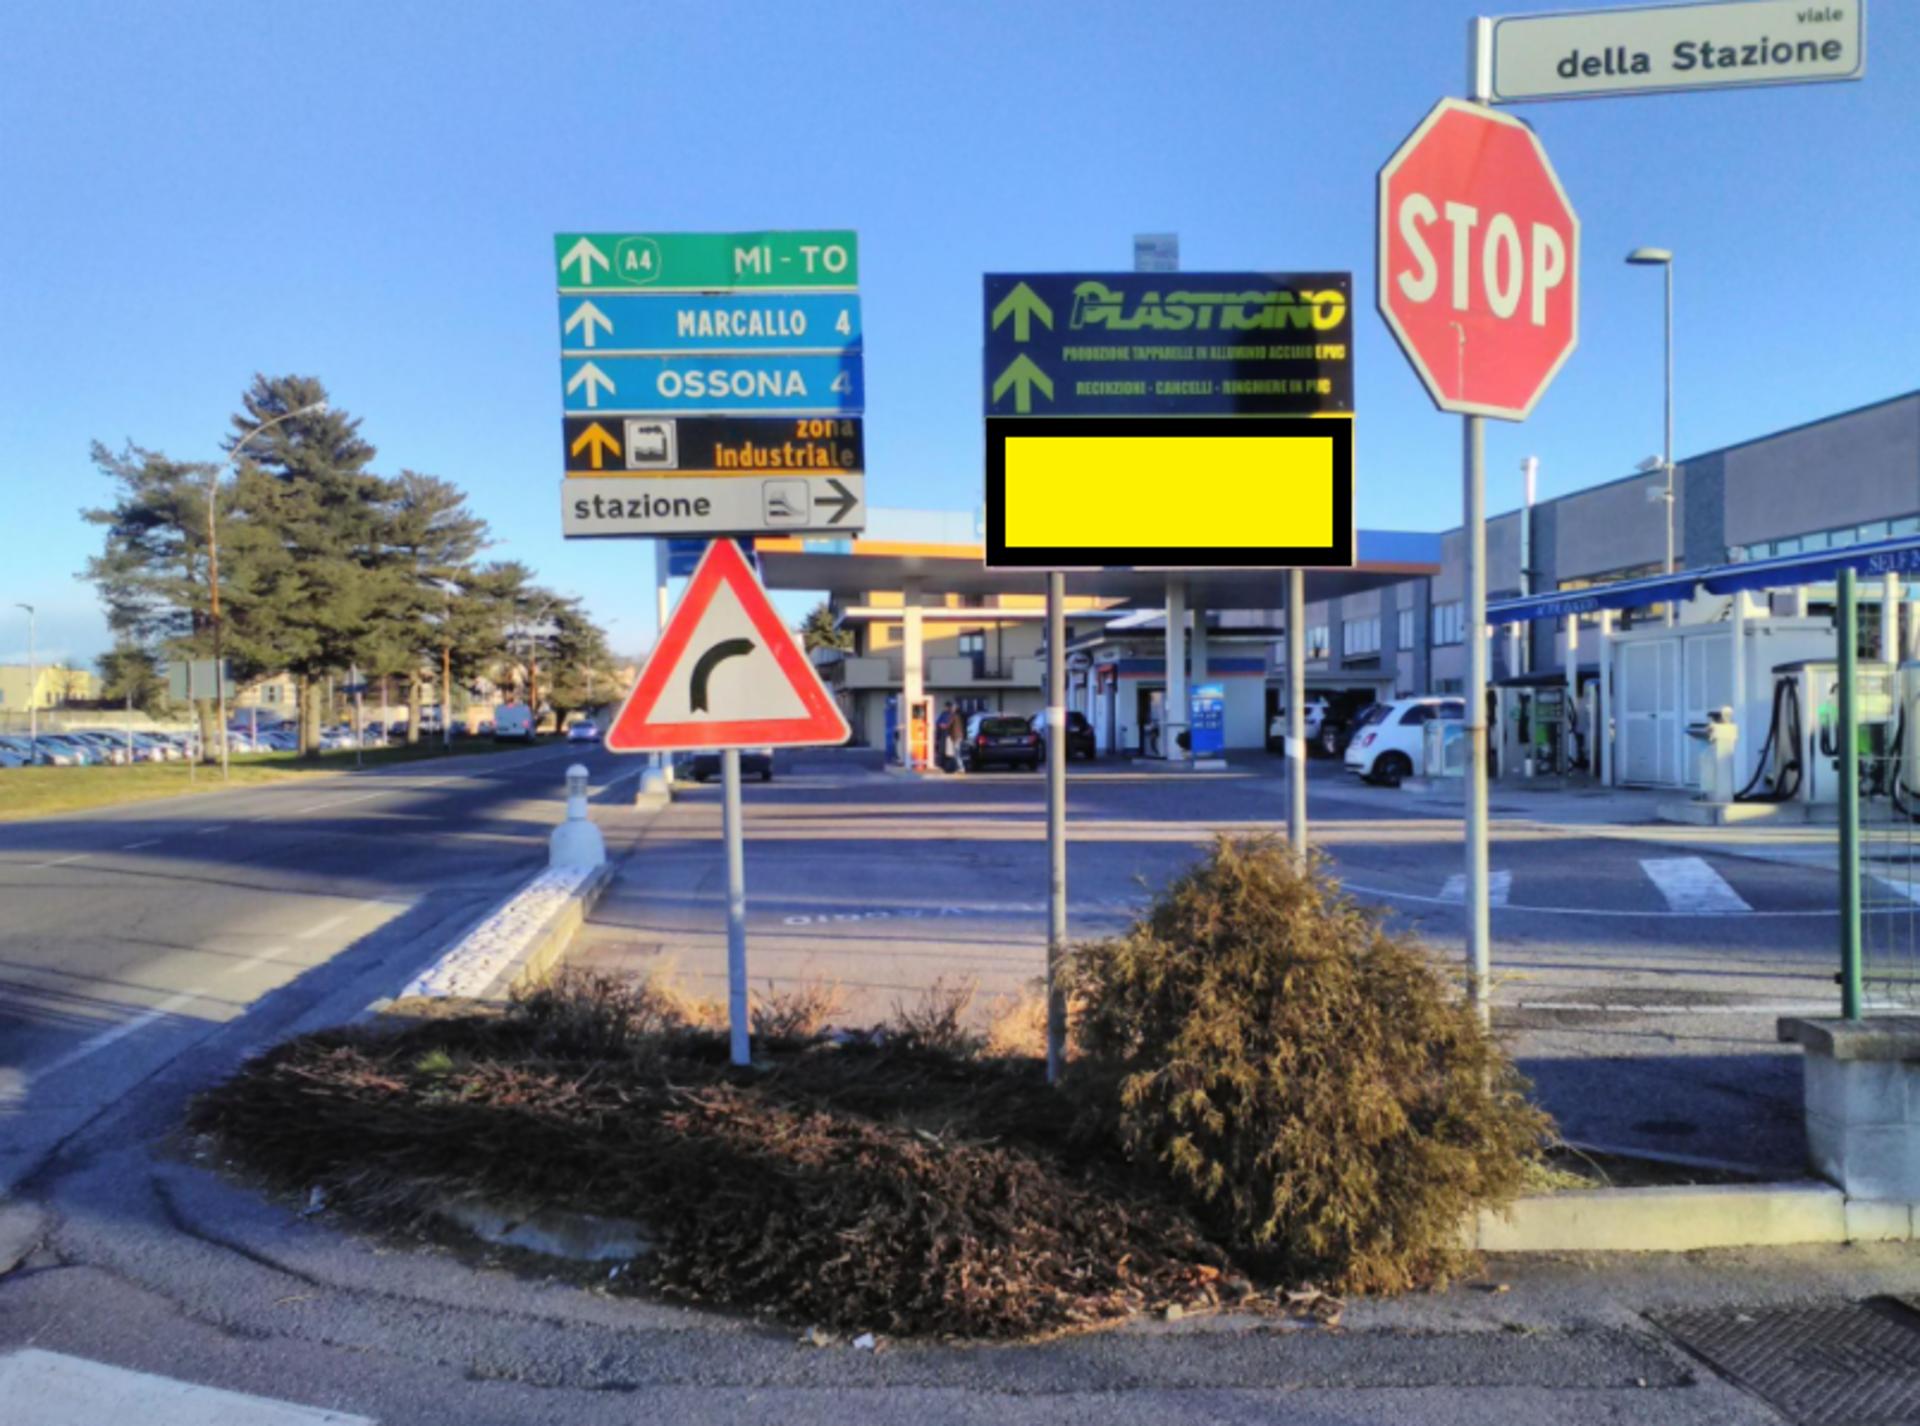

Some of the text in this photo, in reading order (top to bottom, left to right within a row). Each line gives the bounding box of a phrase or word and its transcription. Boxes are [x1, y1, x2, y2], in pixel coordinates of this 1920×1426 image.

[1796, 7, 1843, 24] viale
[1556, 35, 1843, 79] della Stazione
[625, 249, 652, 271] A4
[1397, 192, 1565, 327] STOP
[1069, 281, 1346, 331] PLASTICINO
[677, 309, 851, 337] MARCALLO 4
[656, 369, 852, 398] OSSONA 4
[796, 419, 854, 438] zona
[715, 443, 854, 468] industriale
[574, 494, 711, 520] stazione
